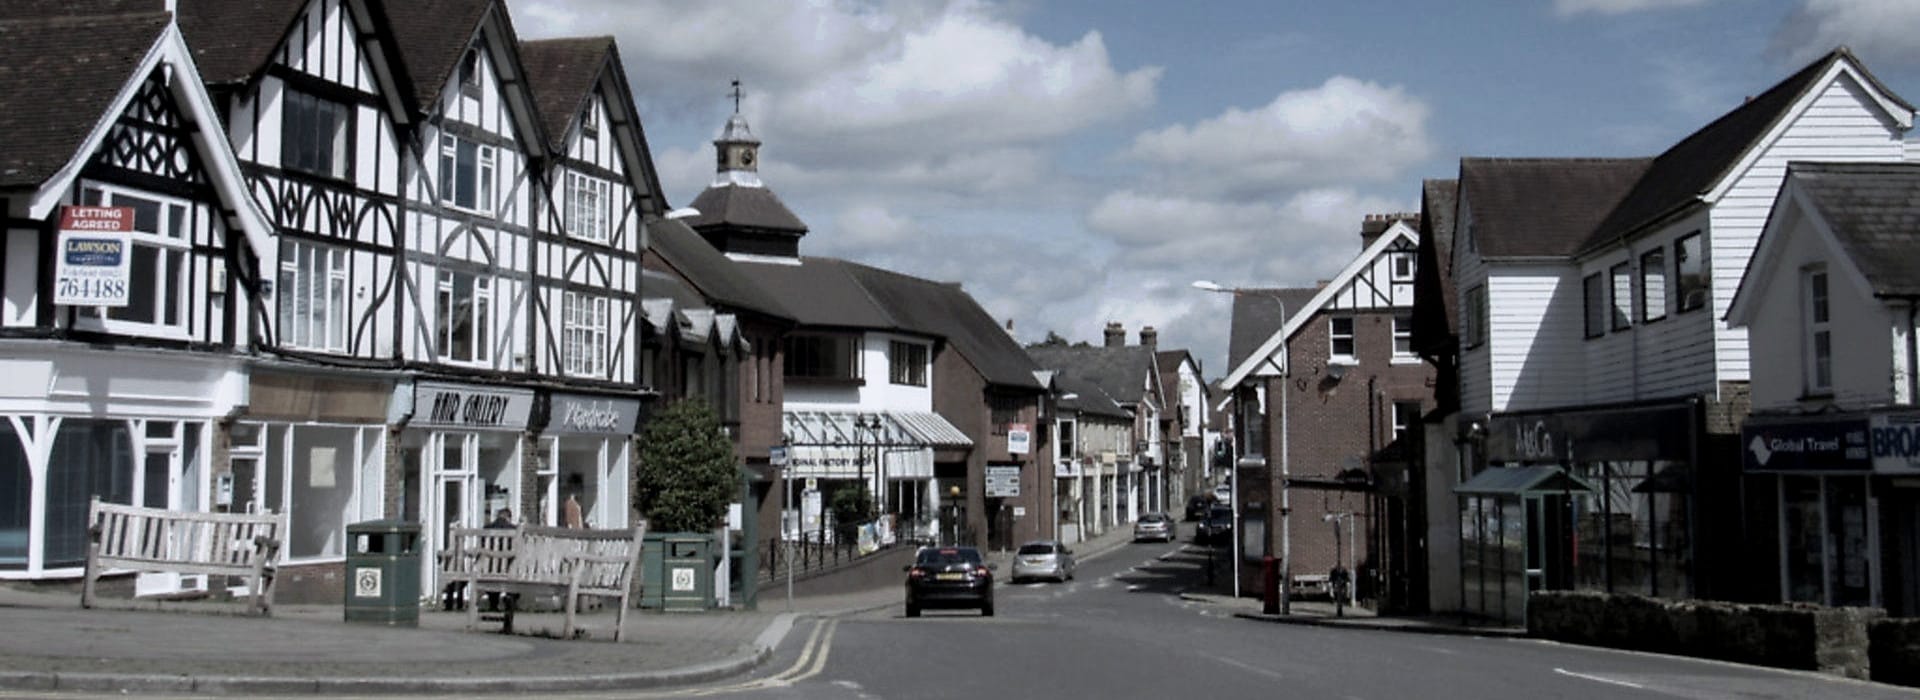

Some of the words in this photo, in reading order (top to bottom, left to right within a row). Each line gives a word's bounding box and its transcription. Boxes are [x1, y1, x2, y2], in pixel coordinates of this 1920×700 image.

[71, 208, 122, 219] LETTING
[72, 220, 121, 230] AGREED
[68, 241, 120, 253] LAWSON
[60, 278, 124, 298] 764488
[430, 391, 460, 423] HAIR
[463, 393, 511, 424] GALLERY
[1770, 437, 1804, 453] Global
[1807, 436, 1840, 452] Travel
[820, 458, 850, 467] FACTORY
